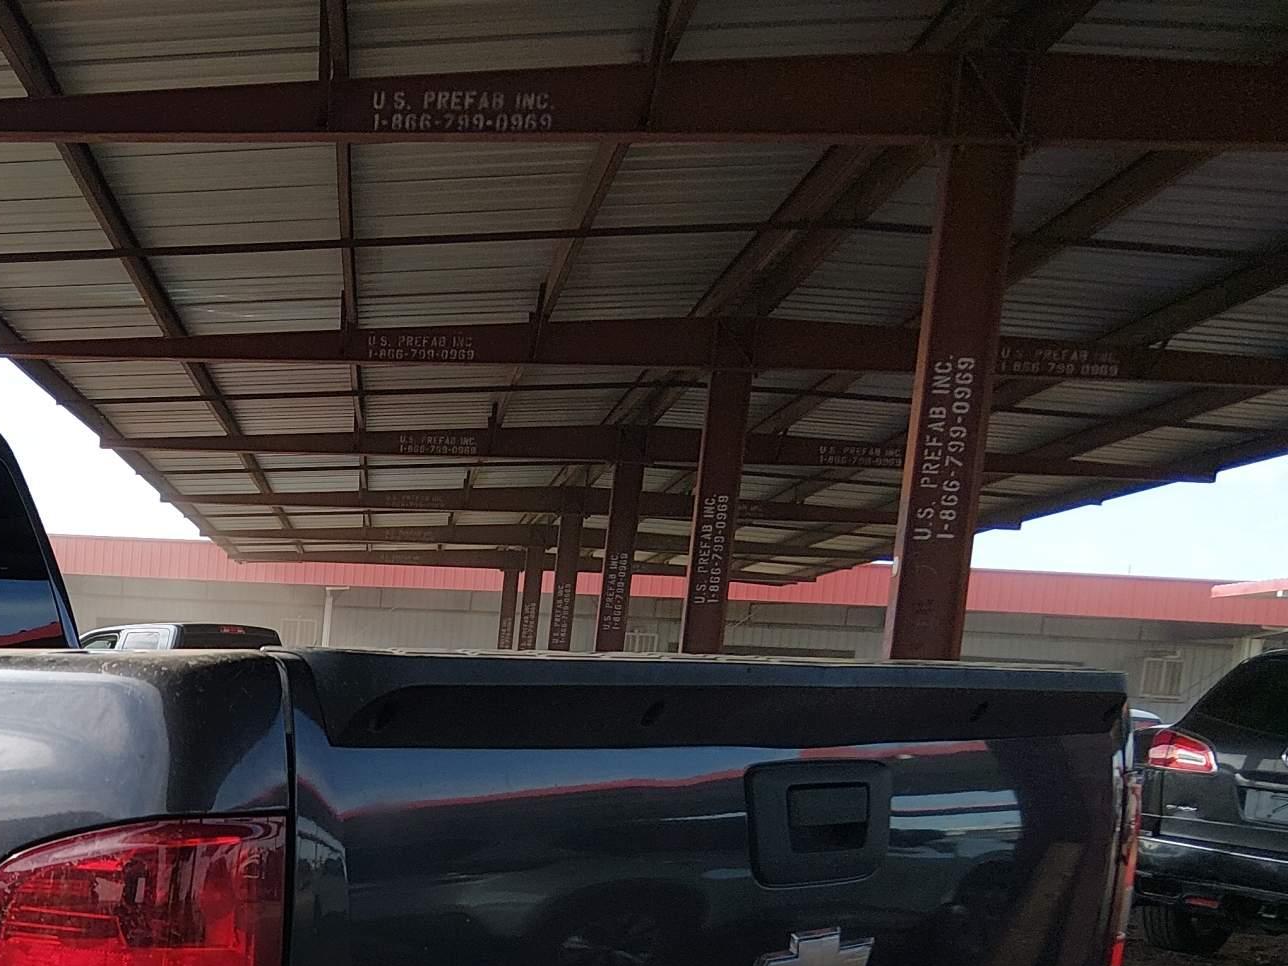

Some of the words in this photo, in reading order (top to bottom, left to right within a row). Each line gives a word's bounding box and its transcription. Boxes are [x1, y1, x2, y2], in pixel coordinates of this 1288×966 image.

[422, 90, 505, 111] PREFAB
[372, 112, 553, 131] 1-866-799-0969
[398, 335, 447, 347] PREFAB
[931, 355, 955, 395] INC.
[920, 405, 947, 489] PREFAB
[936, 356, 975, 540] 1-866-799-0969
[912, 500, 936, 541] U.S.
[697, 524, 713, 574] PREFAB
[707, 495, 729, 603] 1-866-799-0969
